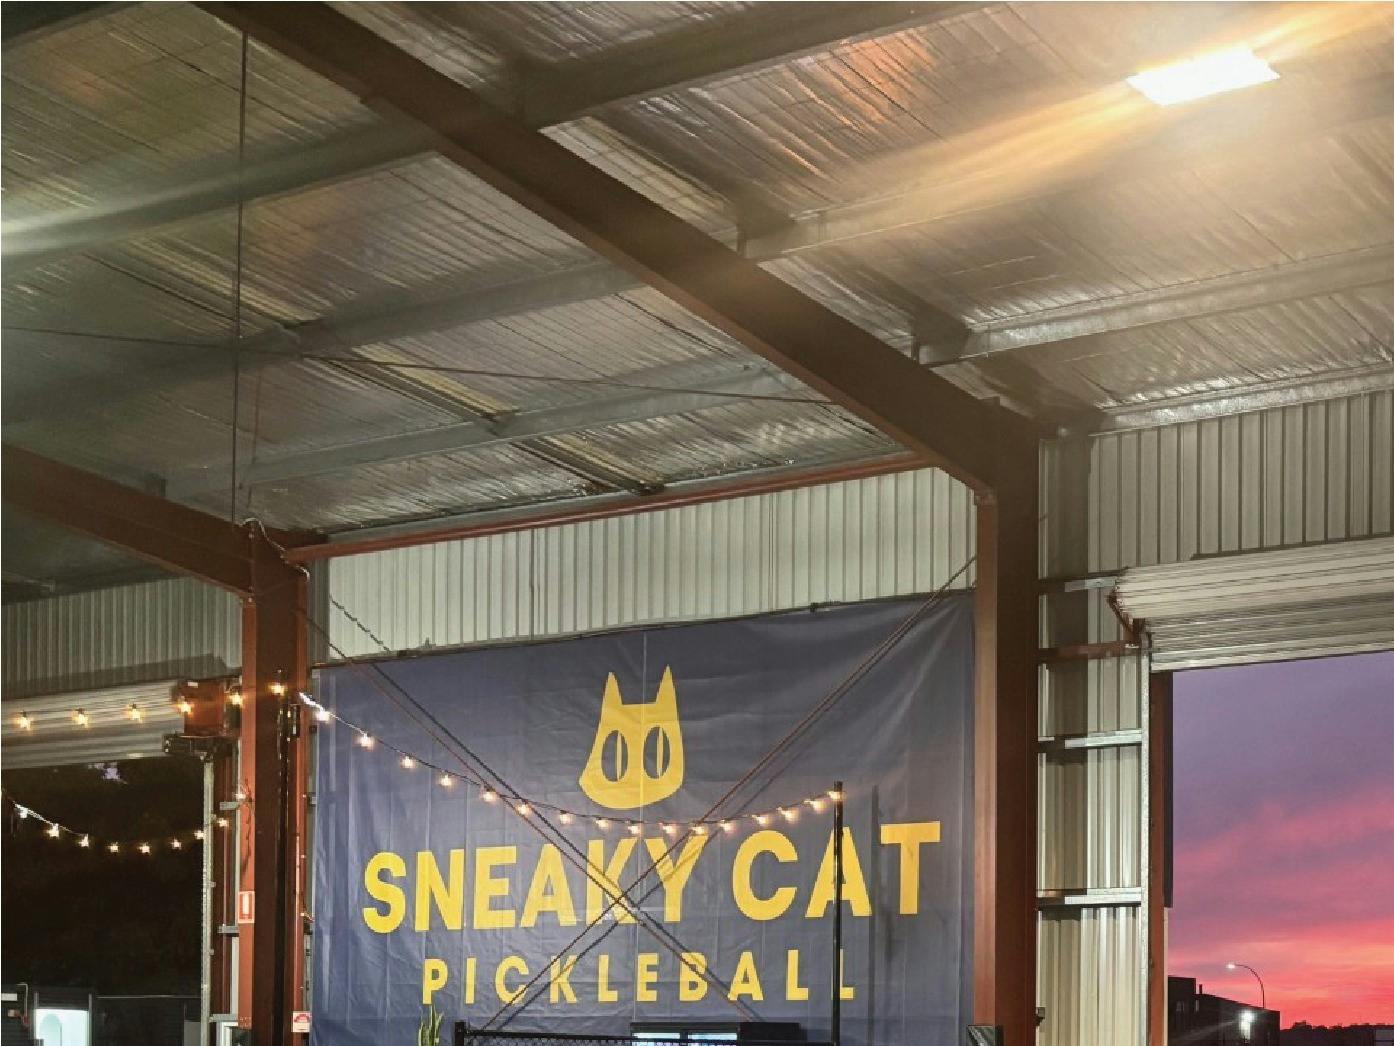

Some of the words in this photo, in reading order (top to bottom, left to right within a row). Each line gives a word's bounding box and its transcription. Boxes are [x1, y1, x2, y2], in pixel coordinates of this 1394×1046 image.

[362, 834, 704, 934] SNEAKY
[733, 820, 942, 922] CAT
[423, 949, 856, 1006] PICKLEBALL
